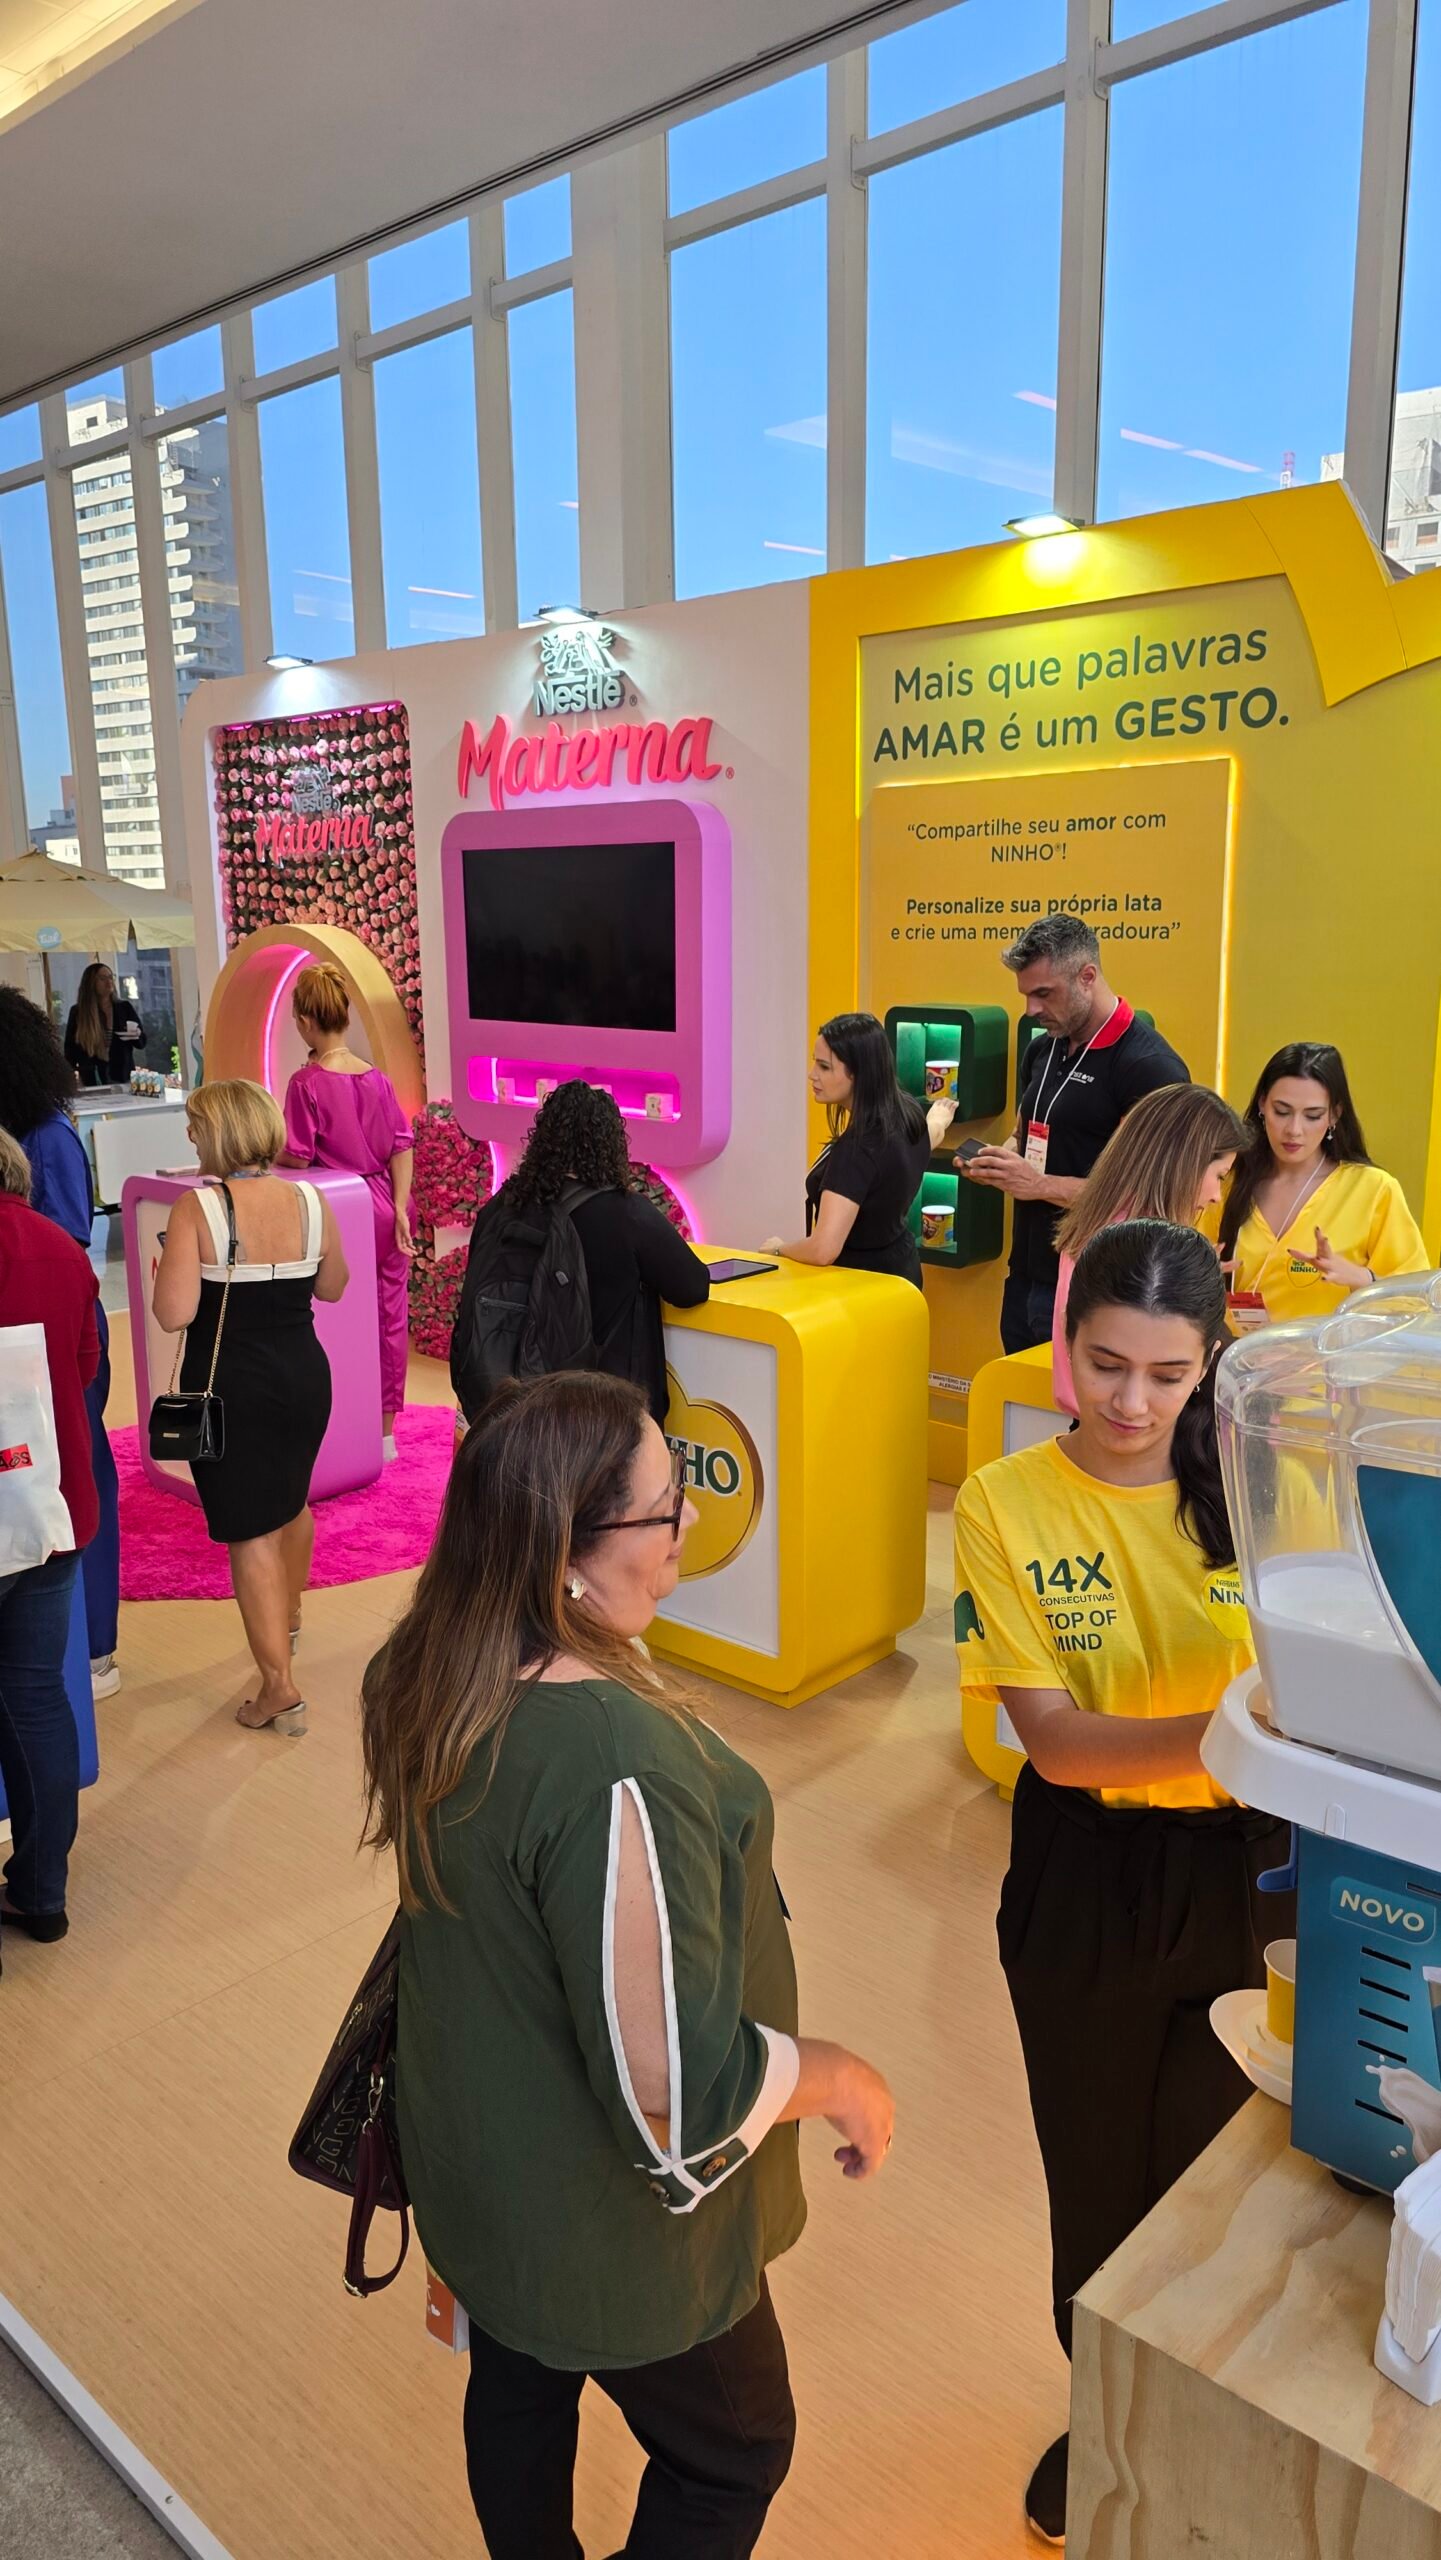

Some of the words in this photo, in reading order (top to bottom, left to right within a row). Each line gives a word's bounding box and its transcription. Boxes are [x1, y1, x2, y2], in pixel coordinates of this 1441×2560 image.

[895, 661, 974, 704] Mais
[988, 657, 1062, 699] que
[1077, 629, 1268, 691] palavras
[873, 718, 986, 763] AMAR
[1000, 712, 1021, 751] é
[1036, 714, 1098, 748] um
[1114, 687, 1290, 740] GESTO.
[255, 812, 375, 866] Materna
[907, 818, 1022, 841] “Compartilhe
[1028, 819, 1060, 834] seu
[1066, 815, 1117, 832] amor
[1123, 813, 1166, 829] com
[907, 897, 1005, 915] Personalize
[1010, 899, 1041, 913] sua
[1047, 894, 1118, 916] própria
[1125, 893, 1162, 912] lata
[891, 927, 900, 940] e
[905, 924, 936, 940] crie
[941, 927, 977, 940] uma
[983, 926, 1025, 940] mem
[1094, 922, 1181, 940] radoura”
[1025, 1551, 1113, 1595] 14X
[1039, 1592, 1115, 1607] CONSECUTIVAS
[1210, 1586, 1245, 1605] NIN
[1044, 1611, 1084, 1631] TOP
[1089, 1609, 1117, 1627] OF
[1340, 1889, 1425, 1932] NOVO
